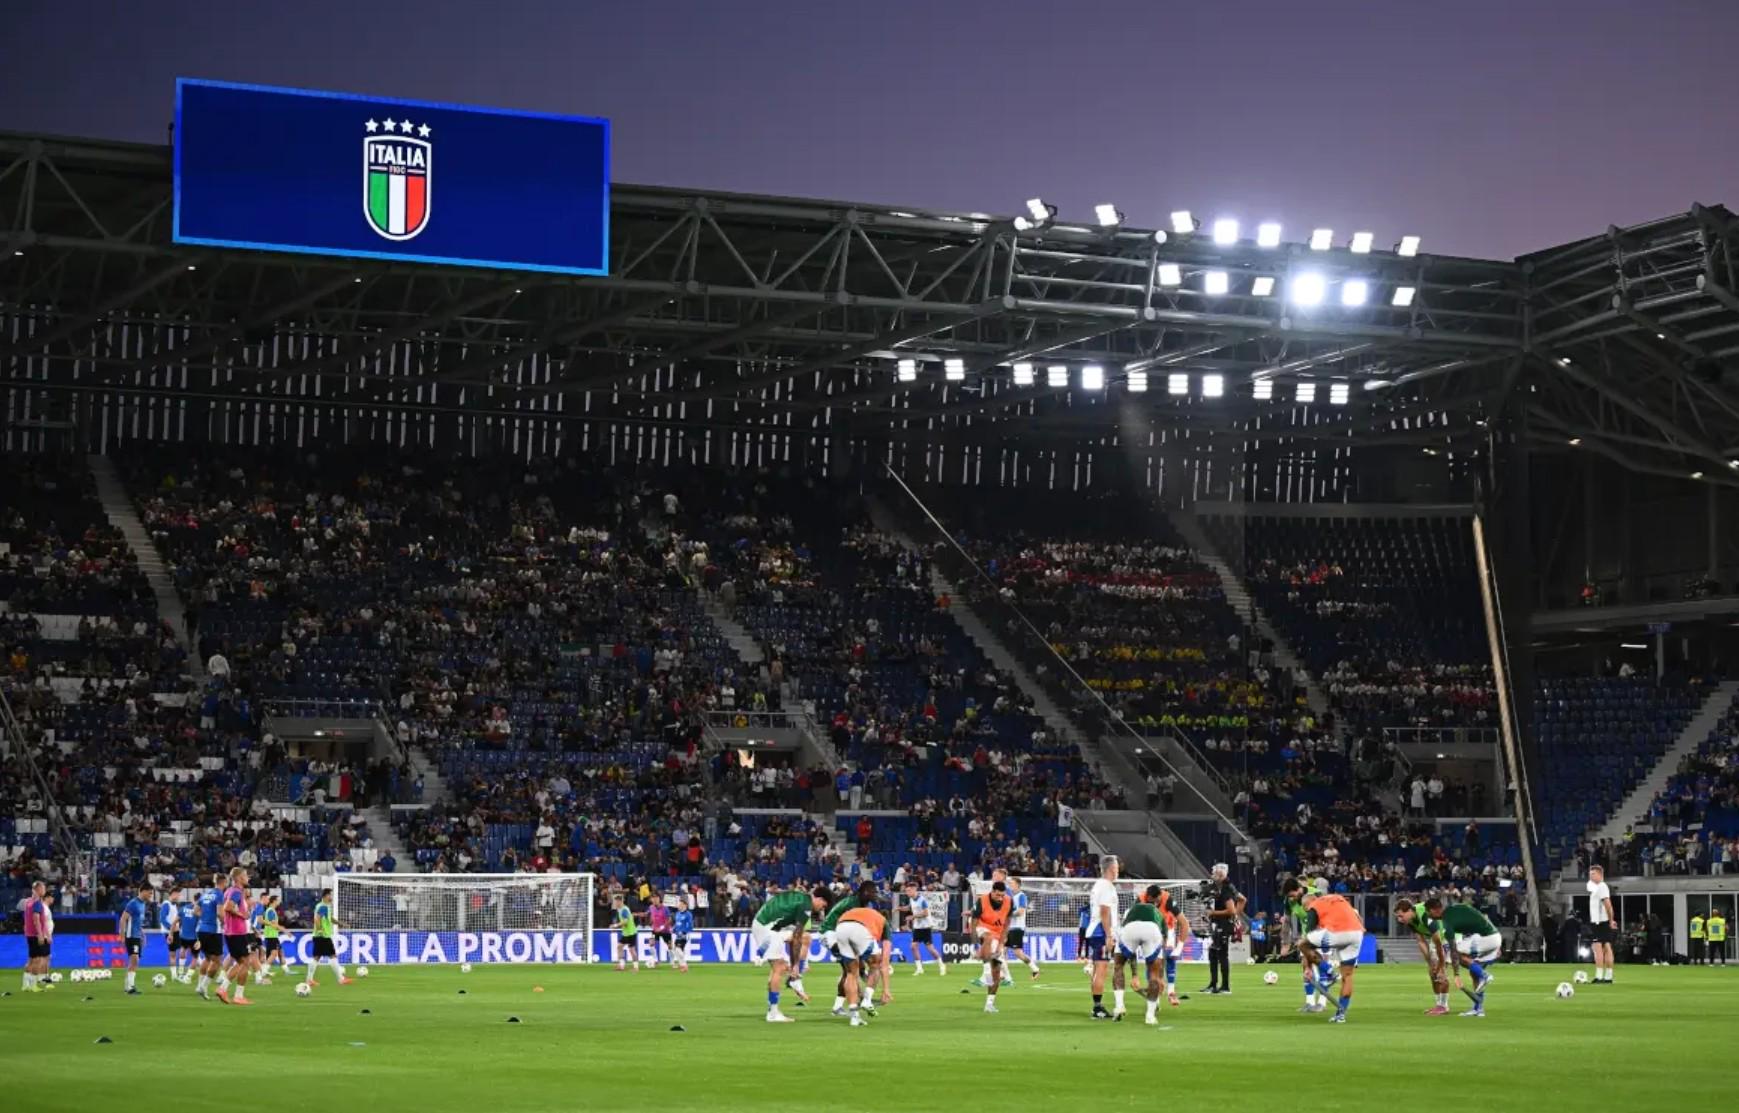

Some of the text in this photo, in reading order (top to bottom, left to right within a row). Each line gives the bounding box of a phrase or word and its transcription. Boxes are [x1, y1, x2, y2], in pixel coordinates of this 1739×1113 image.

[369, 143, 426, 167] ITALIA
[400, 933, 447, 963] LA
[1023, 935, 1063, 961] IM
